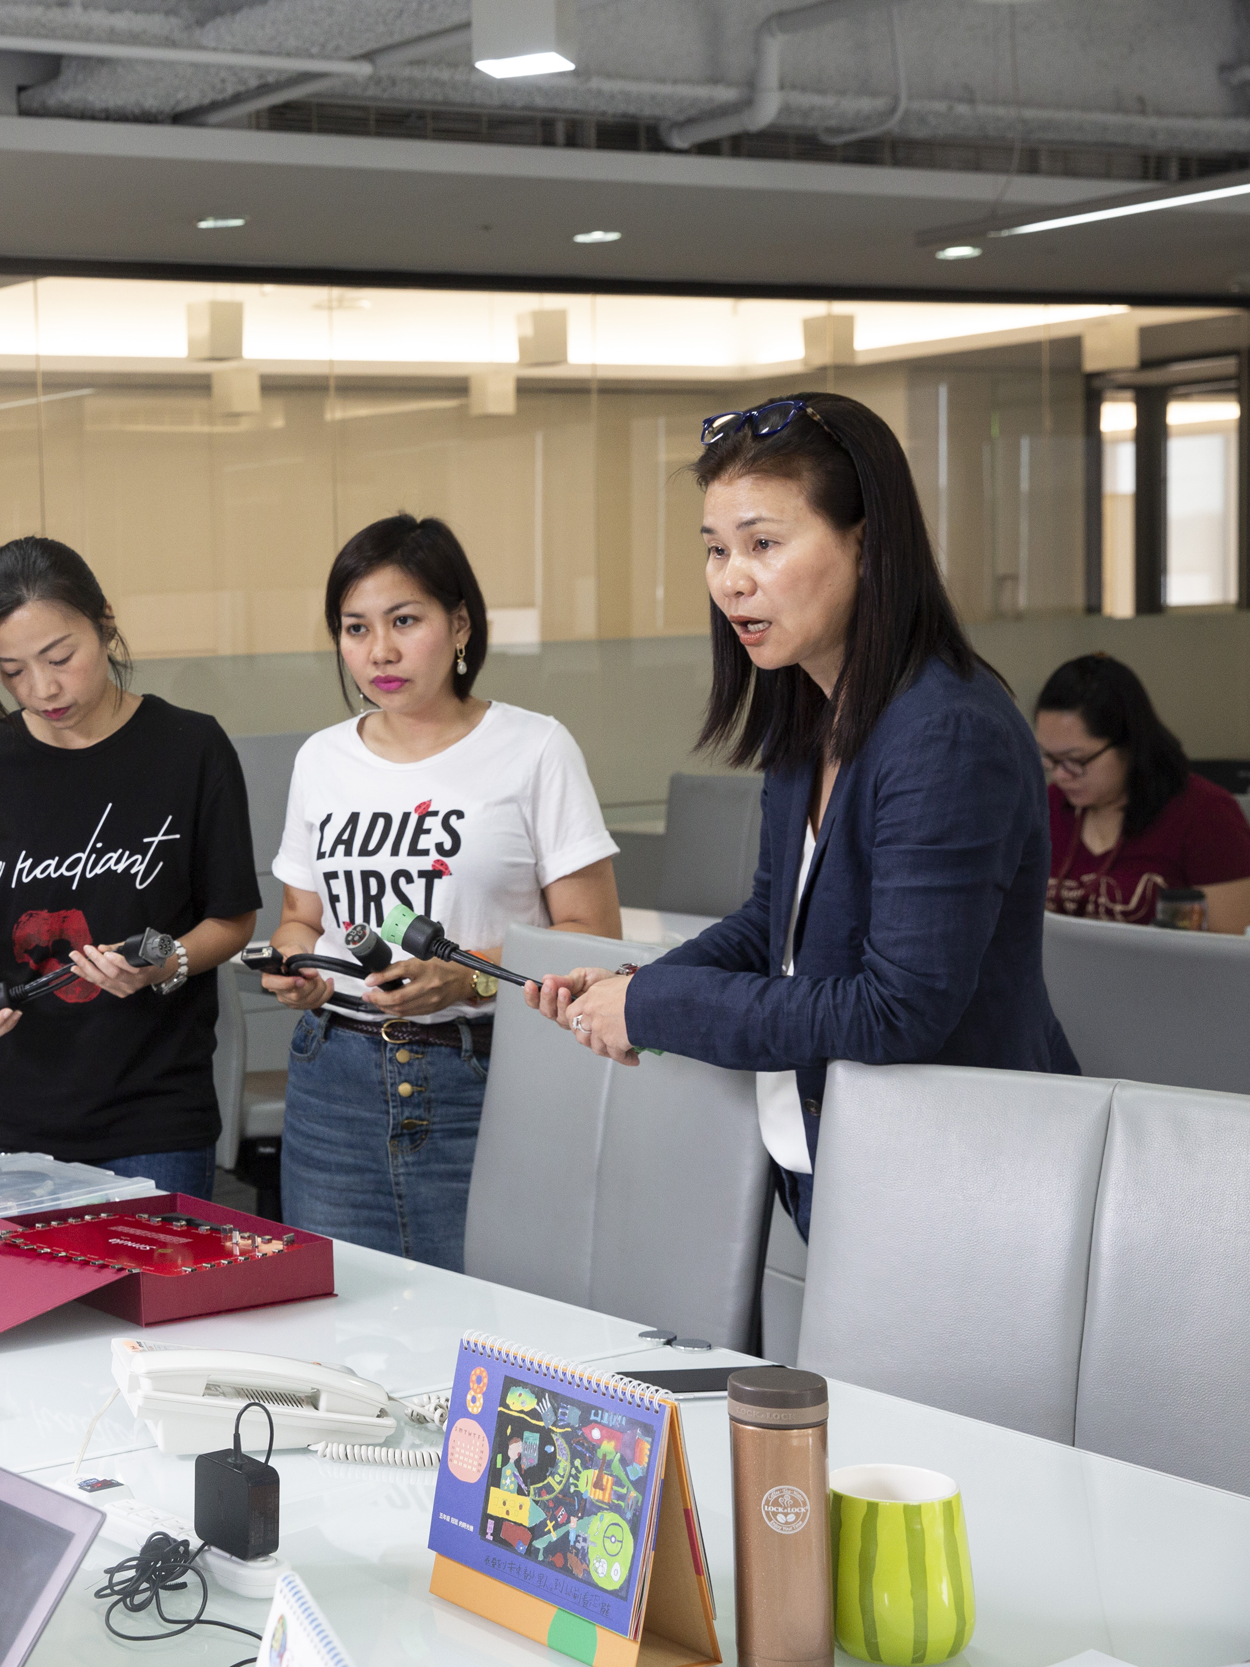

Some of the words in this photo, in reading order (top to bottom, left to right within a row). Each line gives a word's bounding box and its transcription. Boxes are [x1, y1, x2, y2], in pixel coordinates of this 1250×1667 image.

[11, 802, 181, 890] radiant
[316, 809, 465, 861] LADIES
[322, 869, 443, 928] FIRST
